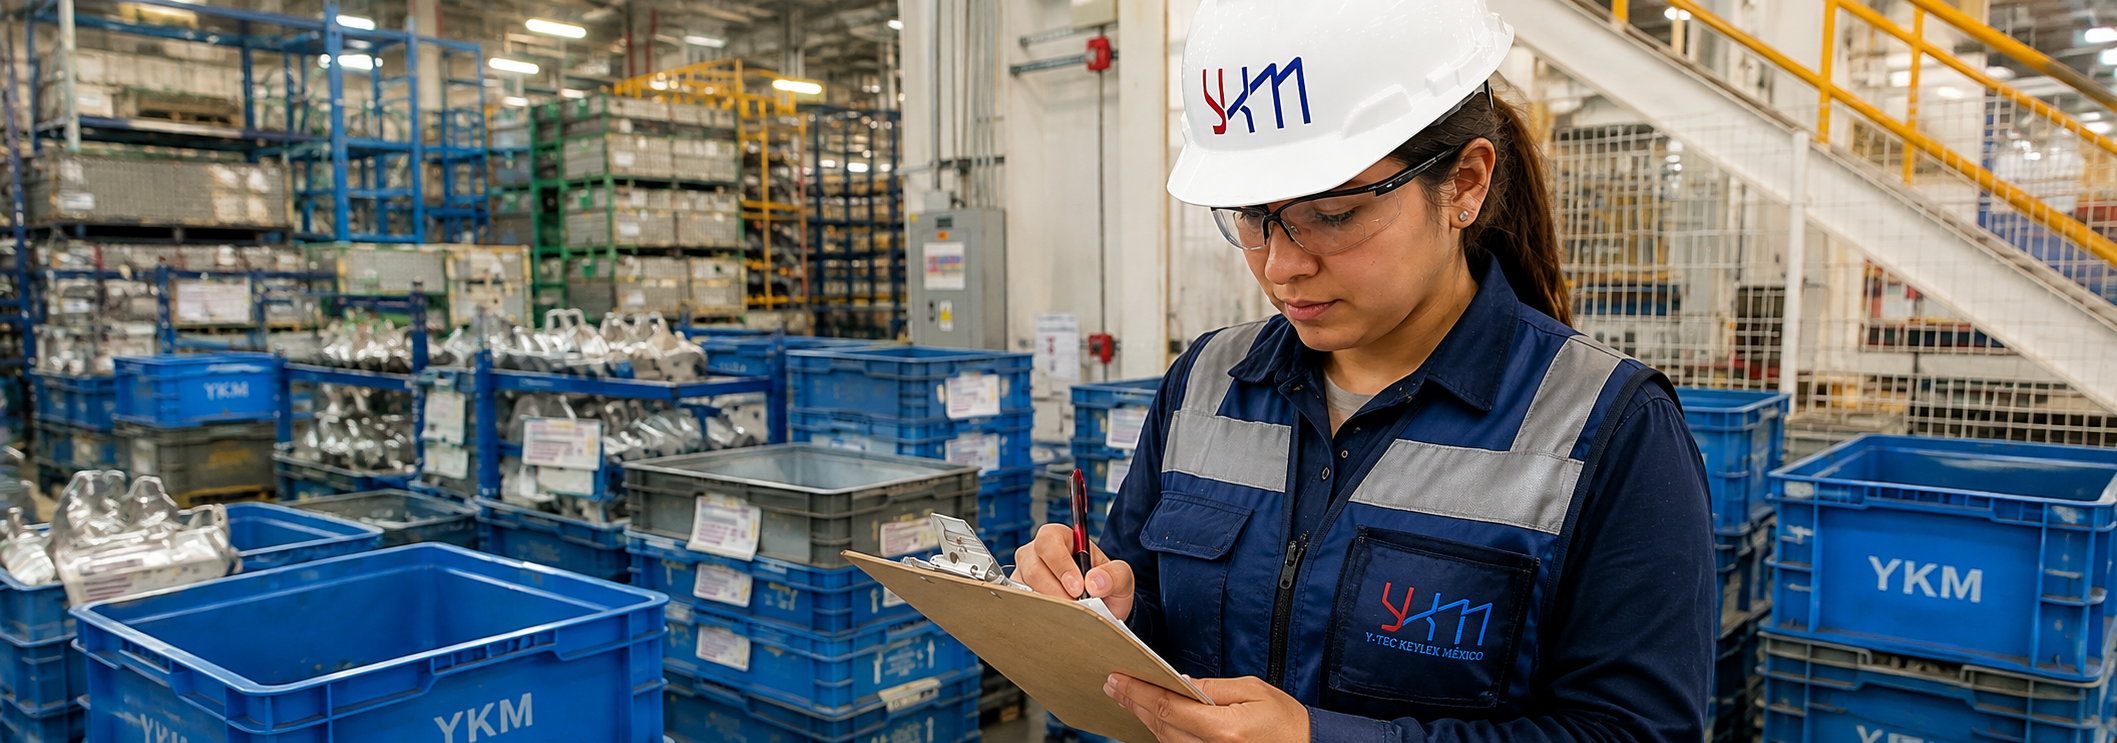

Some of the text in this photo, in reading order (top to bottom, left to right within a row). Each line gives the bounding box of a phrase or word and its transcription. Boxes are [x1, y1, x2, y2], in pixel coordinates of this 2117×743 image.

[203, 381, 249, 400] YKM
[1868, 555, 1983, 603] YKM
[1365, 632, 1484, 661] Y-TEC KEYLEX MÉXICO
[433, 692, 533, 743] YKM
